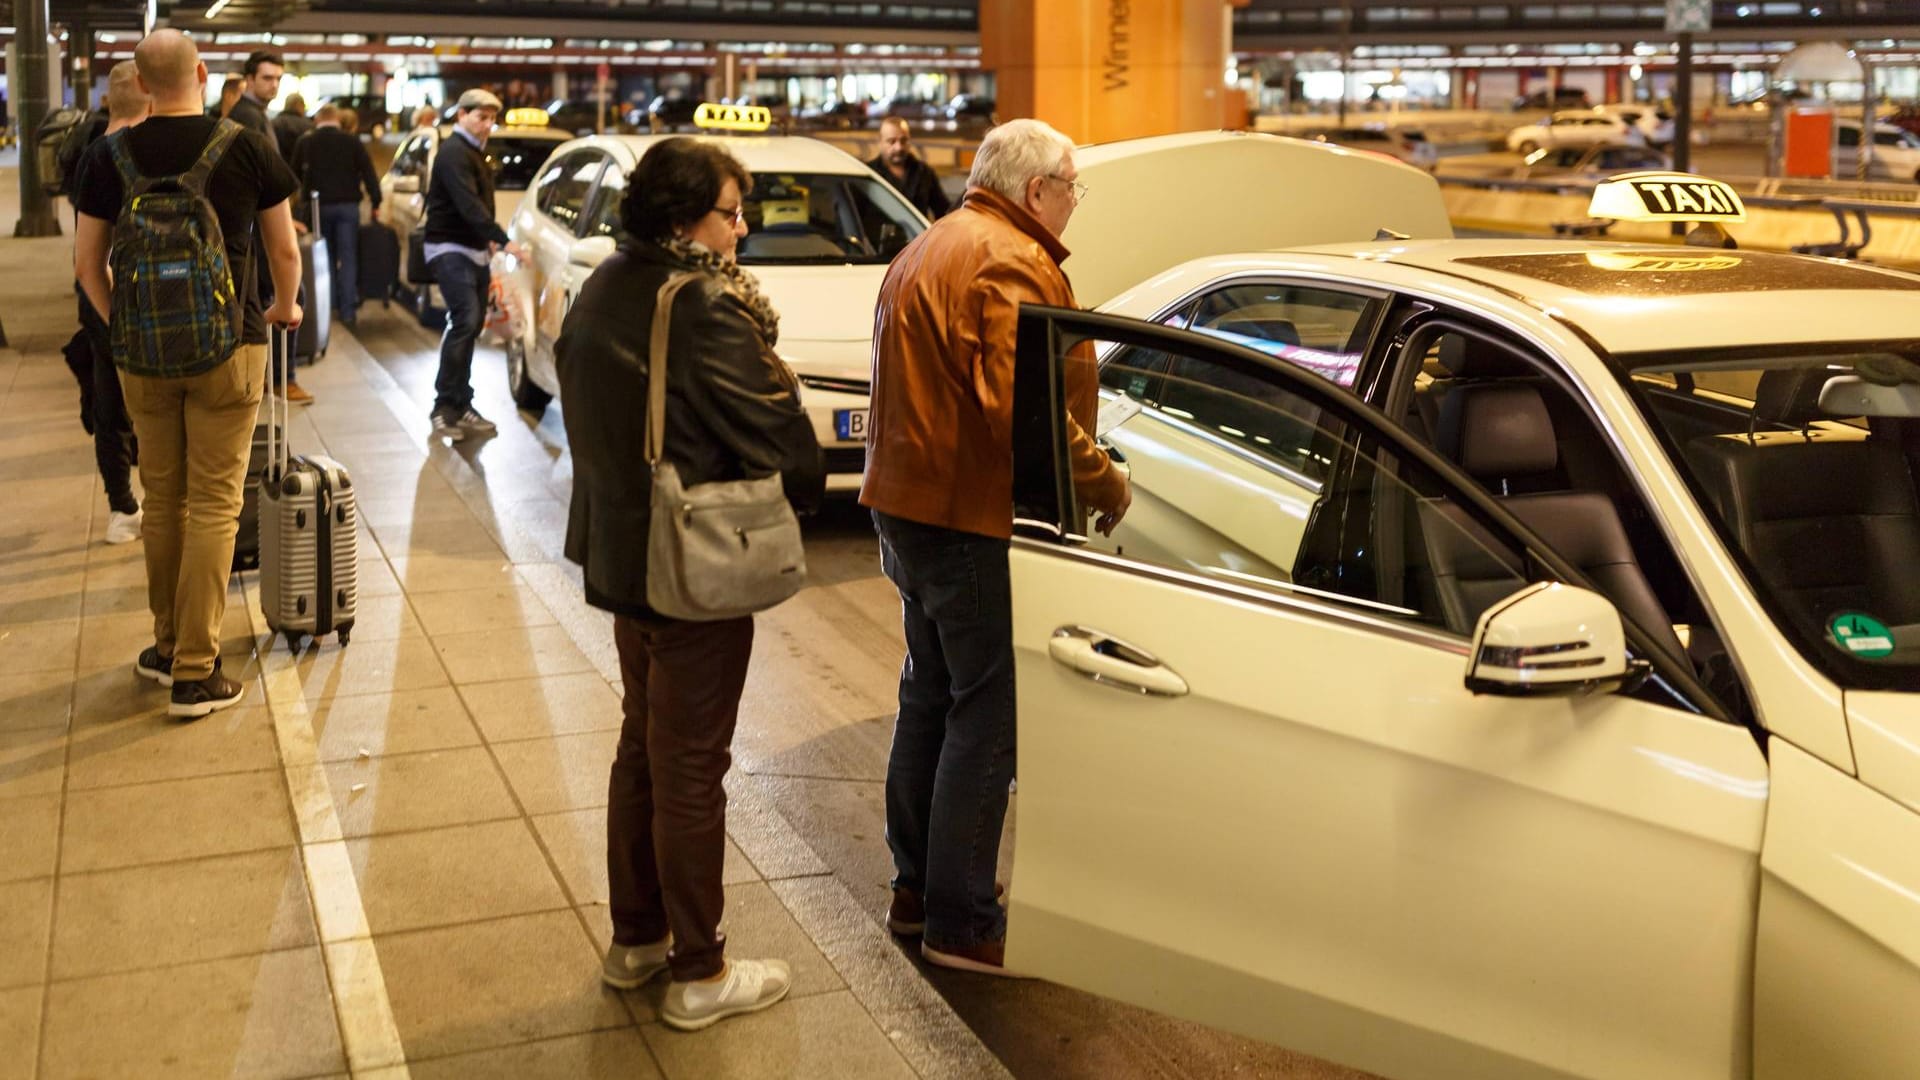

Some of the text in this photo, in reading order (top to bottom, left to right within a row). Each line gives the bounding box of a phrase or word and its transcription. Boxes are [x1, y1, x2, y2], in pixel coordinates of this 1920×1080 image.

[706, 108, 765, 123] TAXI
[1640, 184, 1733, 213] TAXI
[852, 414, 864, 433] B
